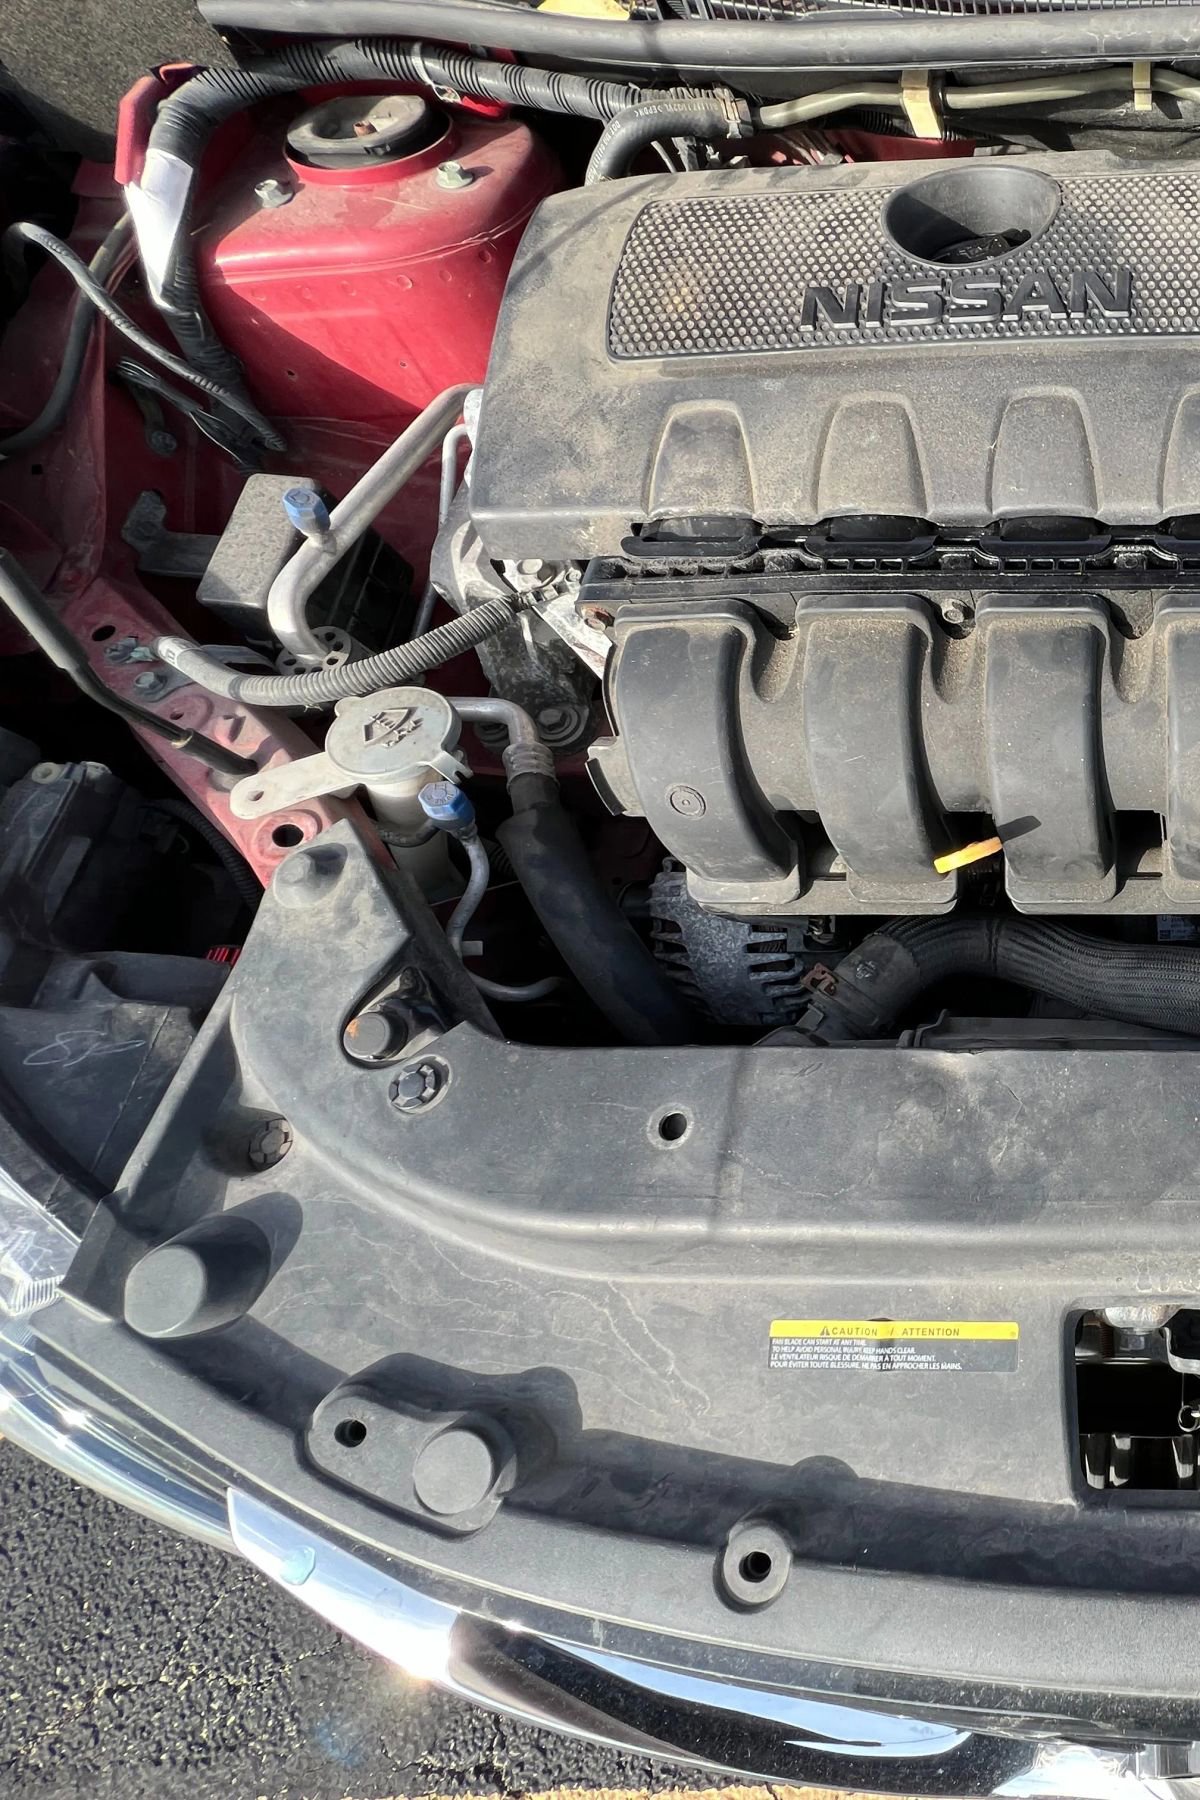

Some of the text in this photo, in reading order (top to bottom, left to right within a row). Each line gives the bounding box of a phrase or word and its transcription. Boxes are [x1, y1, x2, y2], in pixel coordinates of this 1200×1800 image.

[800, 271, 1131, 330] NISSAN
[831, 1327, 878, 1336] CAUTION
[901, 1328, 960, 1336] ATTENTION
[813, 1346, 842, 1354] PERSONAL
[779, 1353, 818, 1361] VENTILATEUR
[819, 1353, 842, 1361] RISQUE
[892, 1362, 929, 1370] APPROCHER
[929, 1362, 940, 1370] LES
